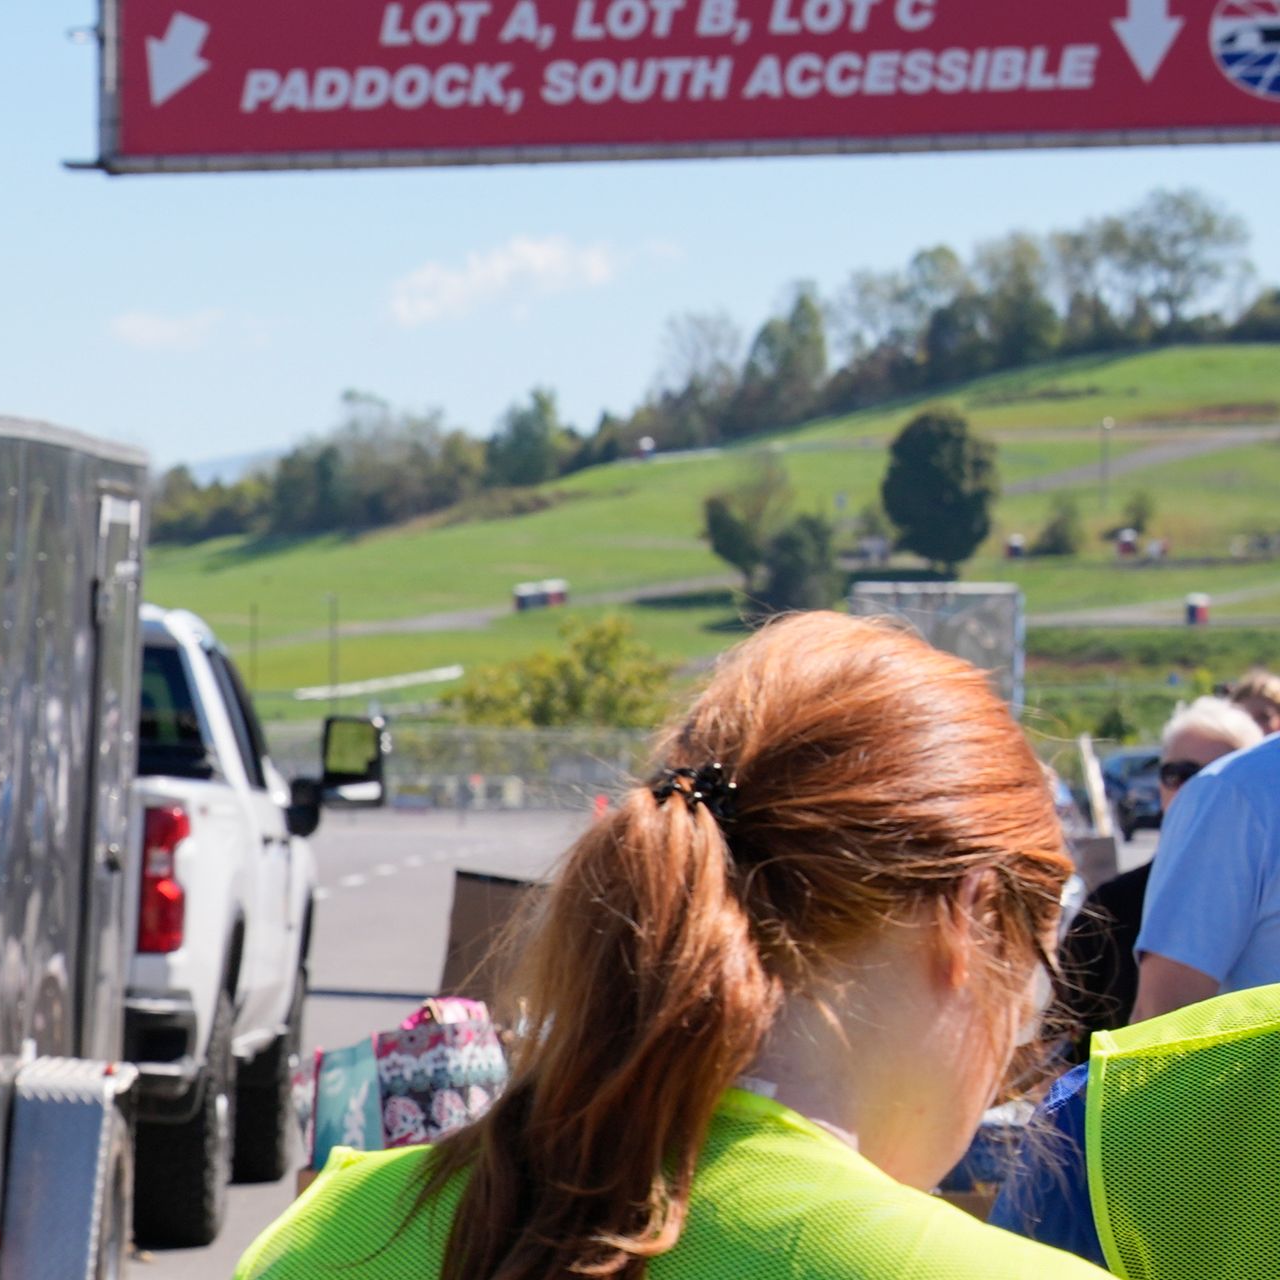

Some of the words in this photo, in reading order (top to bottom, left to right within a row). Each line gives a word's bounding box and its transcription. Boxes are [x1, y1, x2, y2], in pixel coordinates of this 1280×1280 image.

[380, 1, 491, 46] LOT
[501, 0, 553, 48] A,
[573, 0, 686, 40] LOT
[696, 0, 750, 43] B,
[768, 0, 871, 34] LOT
[895, 0, 936, 31] C
[242, 63, 523, 113] PADDOCK,
[542, 57, 732, 104] SOUTH
[744, 45, 1098, 97] ACCESSIBLE
